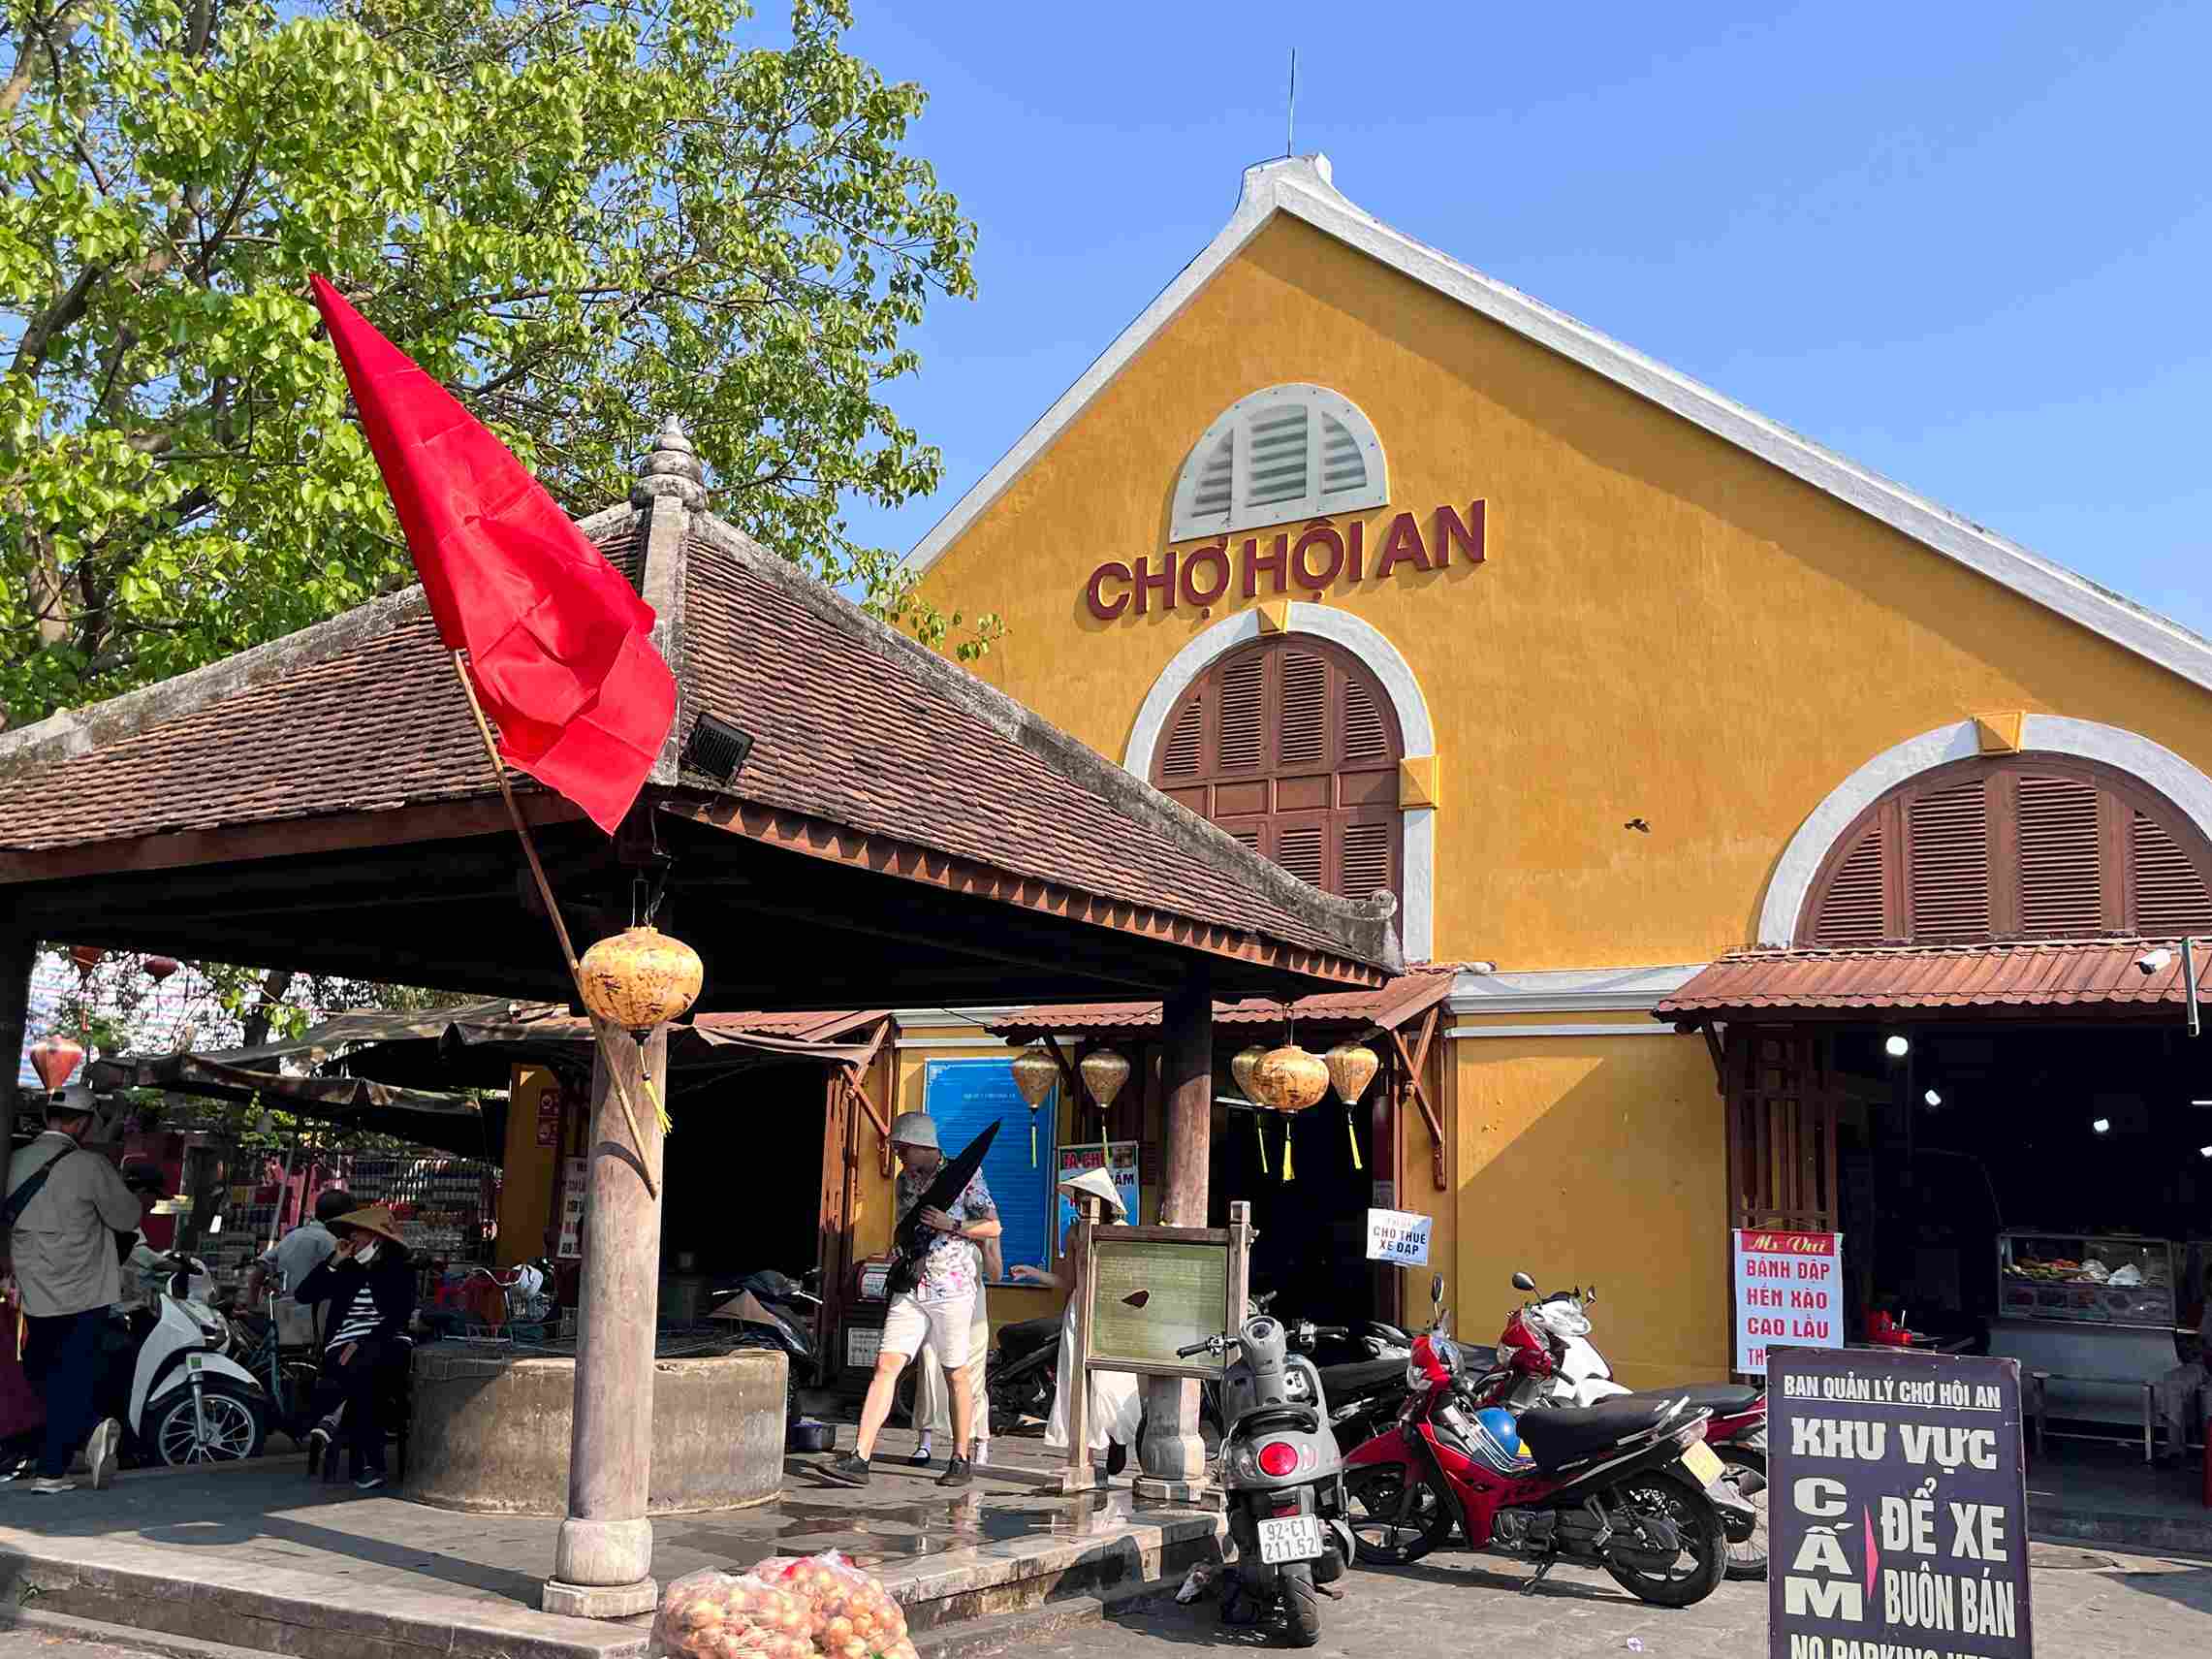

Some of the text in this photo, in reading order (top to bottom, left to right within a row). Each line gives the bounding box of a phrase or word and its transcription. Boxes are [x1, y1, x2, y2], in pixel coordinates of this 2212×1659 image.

[1087, 497, 1488, 619] CHỢ HỘI AN
[1379, 1239, 1394, 1251] XE
[1746, 1256, 1790, 1278] BÁNH
[1790, 1287, 1828, 1309] XÀO
[1747, 1317, 1785, 1337] CAO
[1784, 1371, 2002, 1412] BAN QUẢN LÝ CHỢ HỘI AN
[1790, 1417, 1998, 1475] KHU VỰC
[1880, 1477, 2007, 1562] ĐỂ XE
[1785, 1477, 1863, 1622] CẤM
[1883, 1560, 2017, 1639] BUÔN BÁN
[1790, 1634, 1824, 1659] NO
